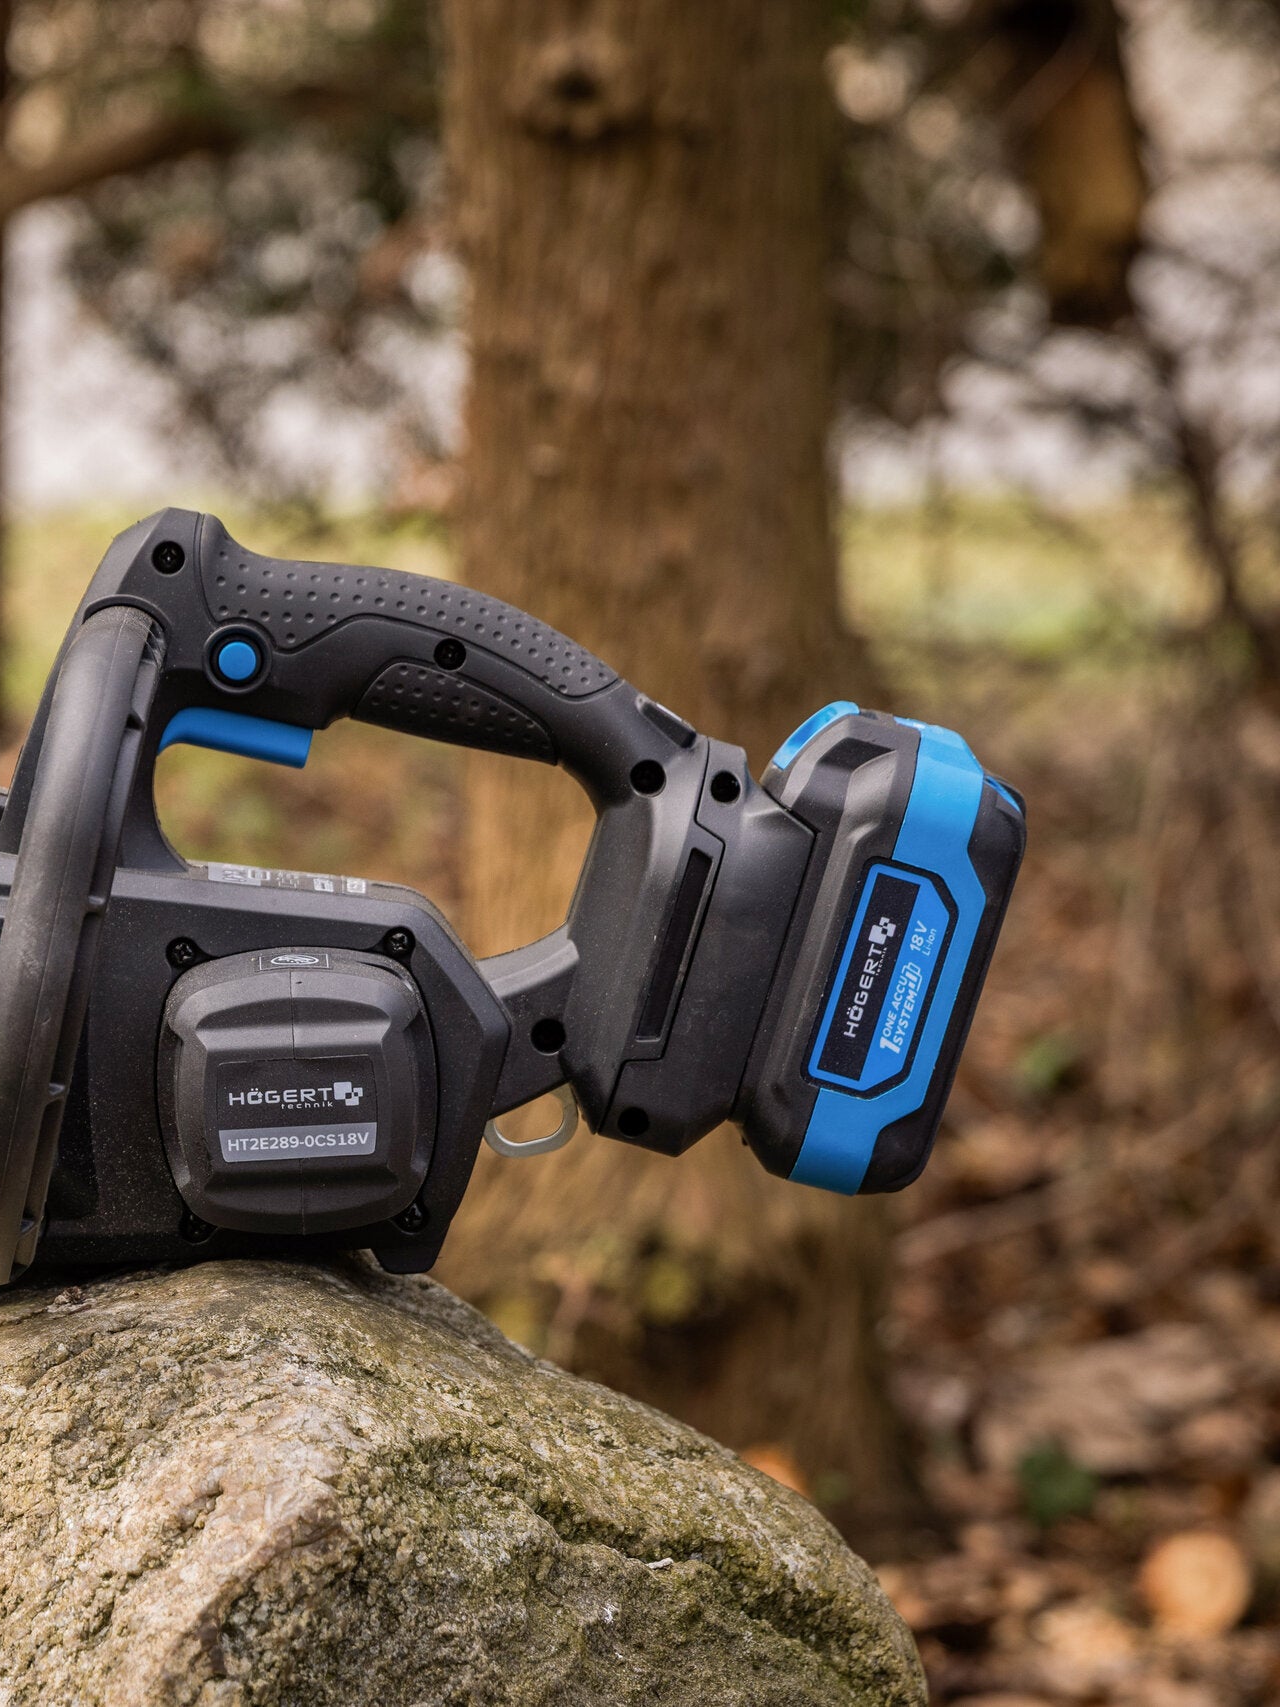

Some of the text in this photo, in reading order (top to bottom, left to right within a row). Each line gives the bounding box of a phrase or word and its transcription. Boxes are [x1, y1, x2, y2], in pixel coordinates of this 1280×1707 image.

[843, 943, 882, 1038] HÖGERT
[882, 975, 908, 1037] ONE ACCU
[893, 986, 918, 1046] SYSTEM
[228, 1087, 333, 1106] HÖGERT
[281, 1101, 334, 1110] technik
